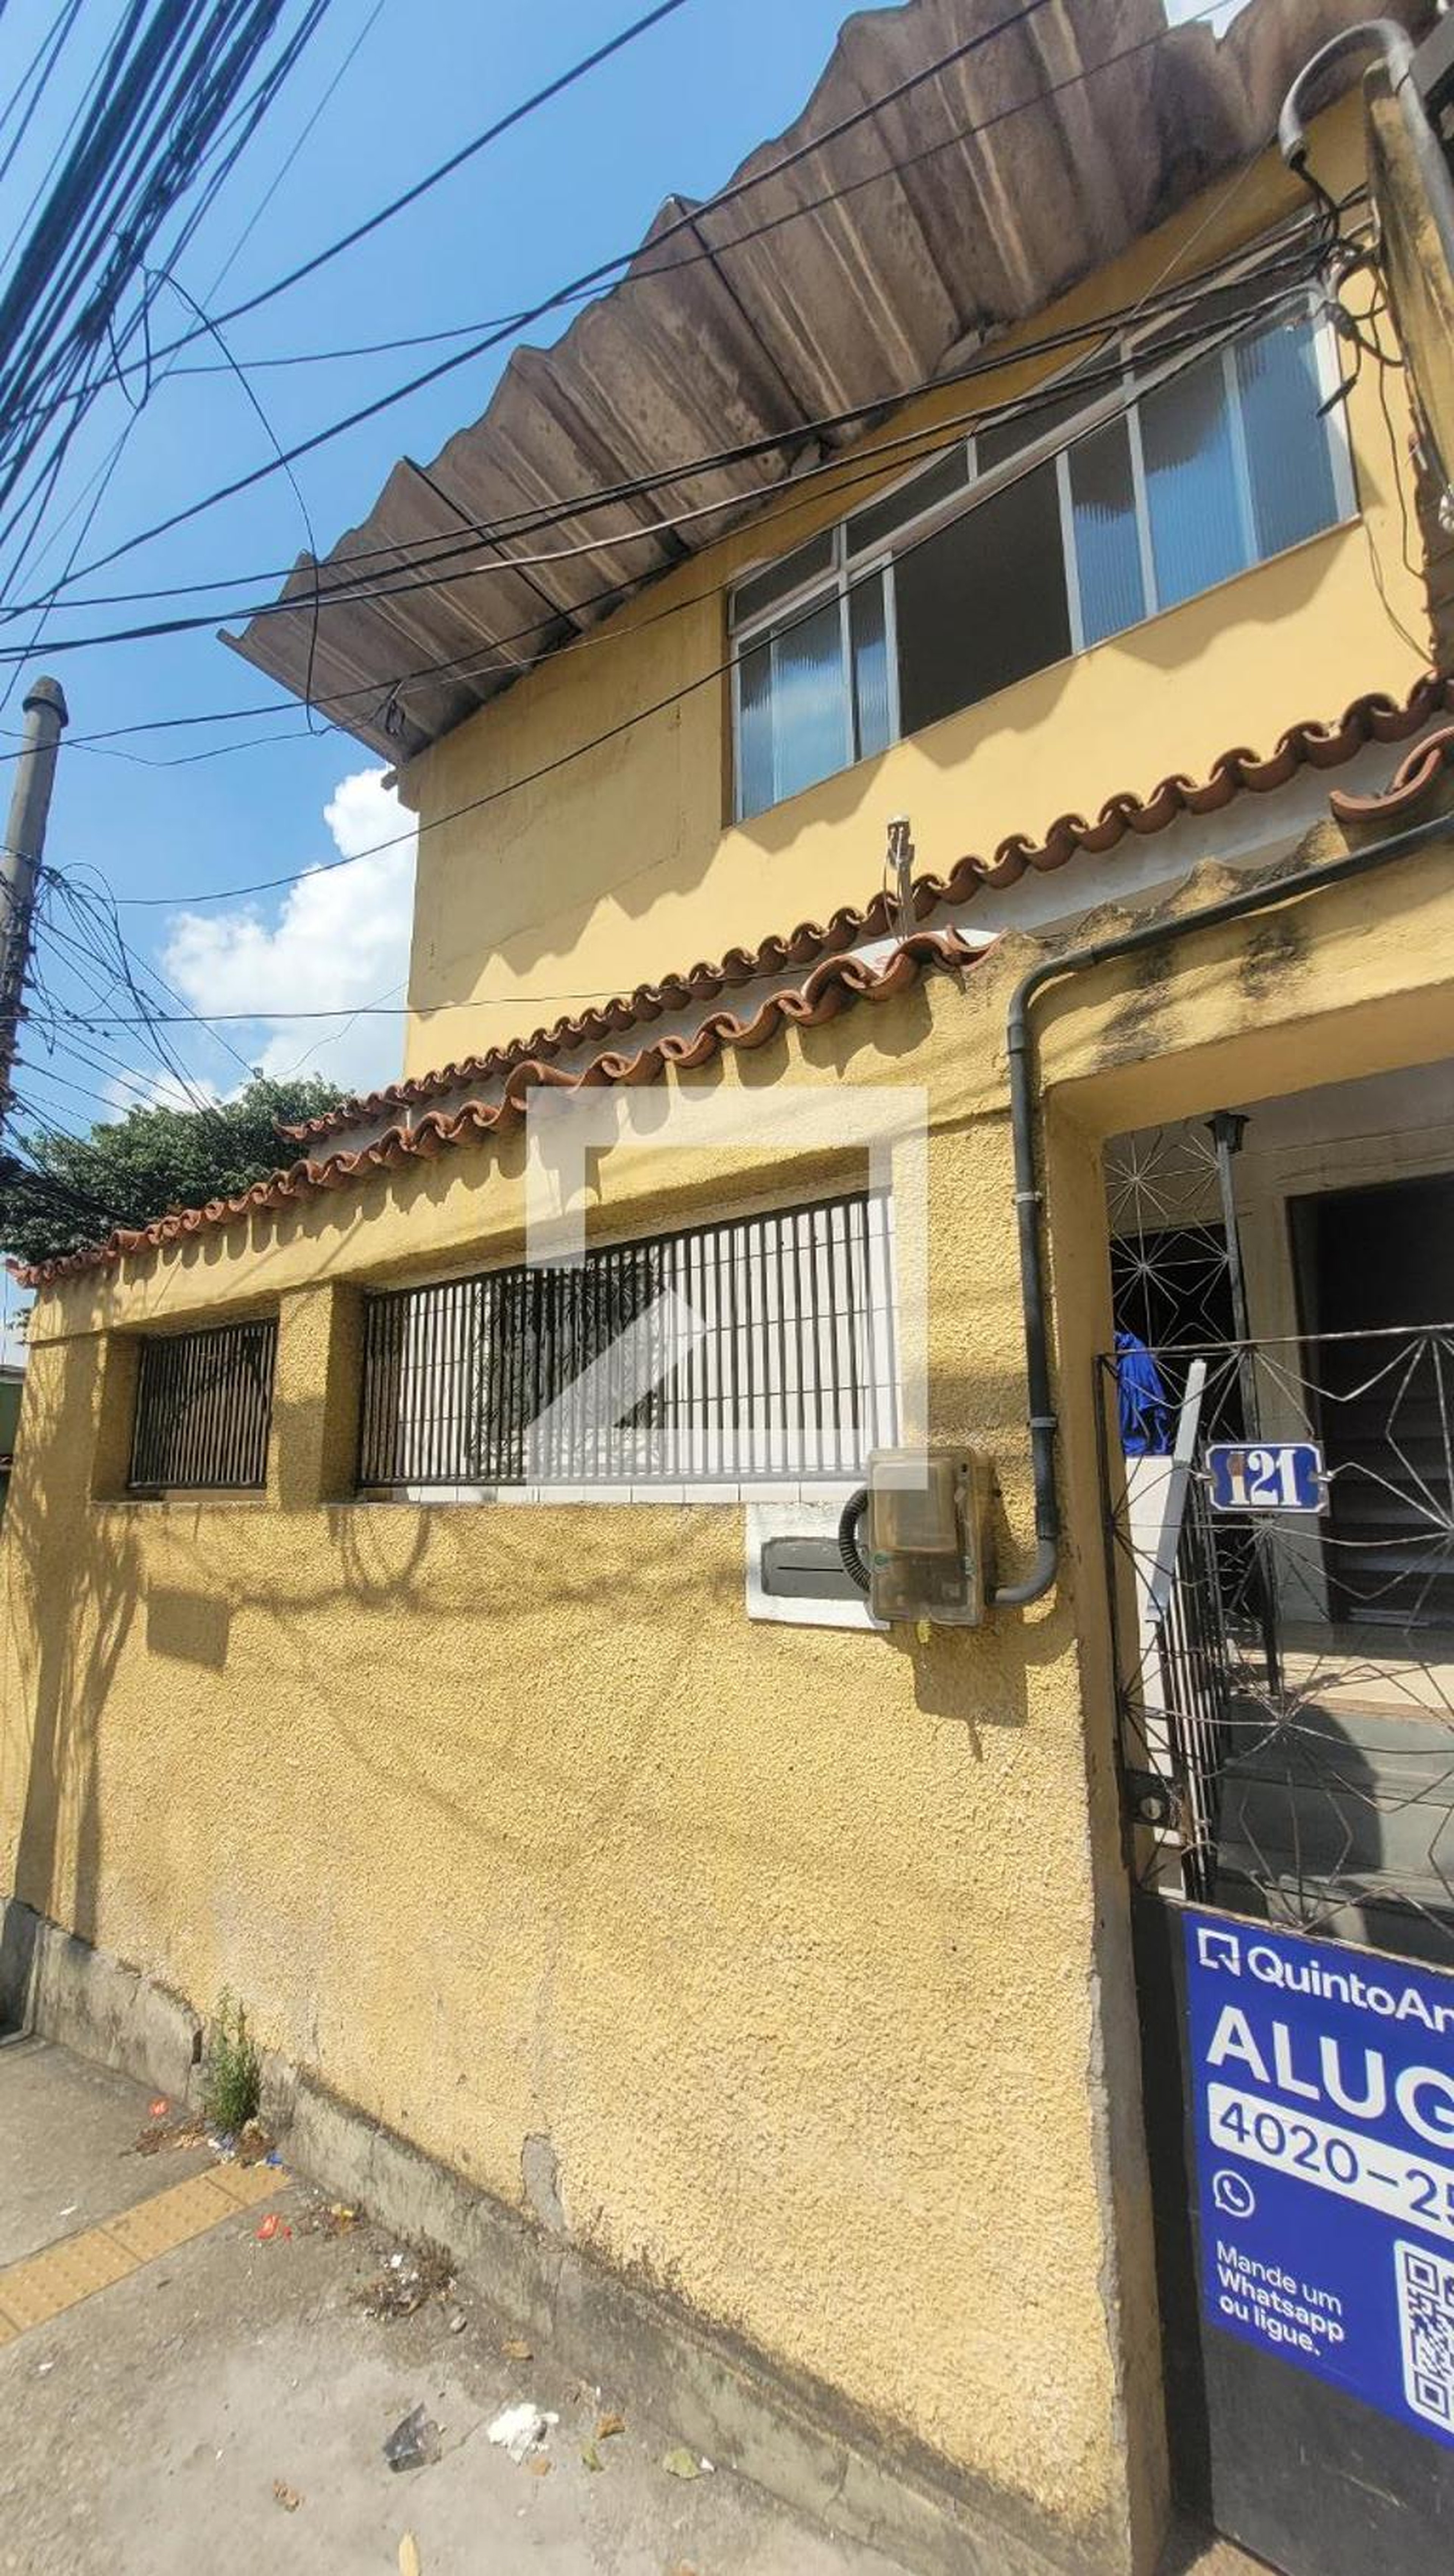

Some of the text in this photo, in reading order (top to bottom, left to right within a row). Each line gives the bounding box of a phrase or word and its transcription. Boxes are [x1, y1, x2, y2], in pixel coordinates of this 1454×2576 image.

[1226, 1449, 1302, 1506] 121
[1205, 2004, 1454, 2150] ALUG
[1219, 2102, 1454, 2227] 4020-2
[1217, 2240, 1342, 2316] Mande um
[1217, 2262, 1345, 2343] Whatsapp
[1220, 2295, 1321, 2356] ou ligue.
